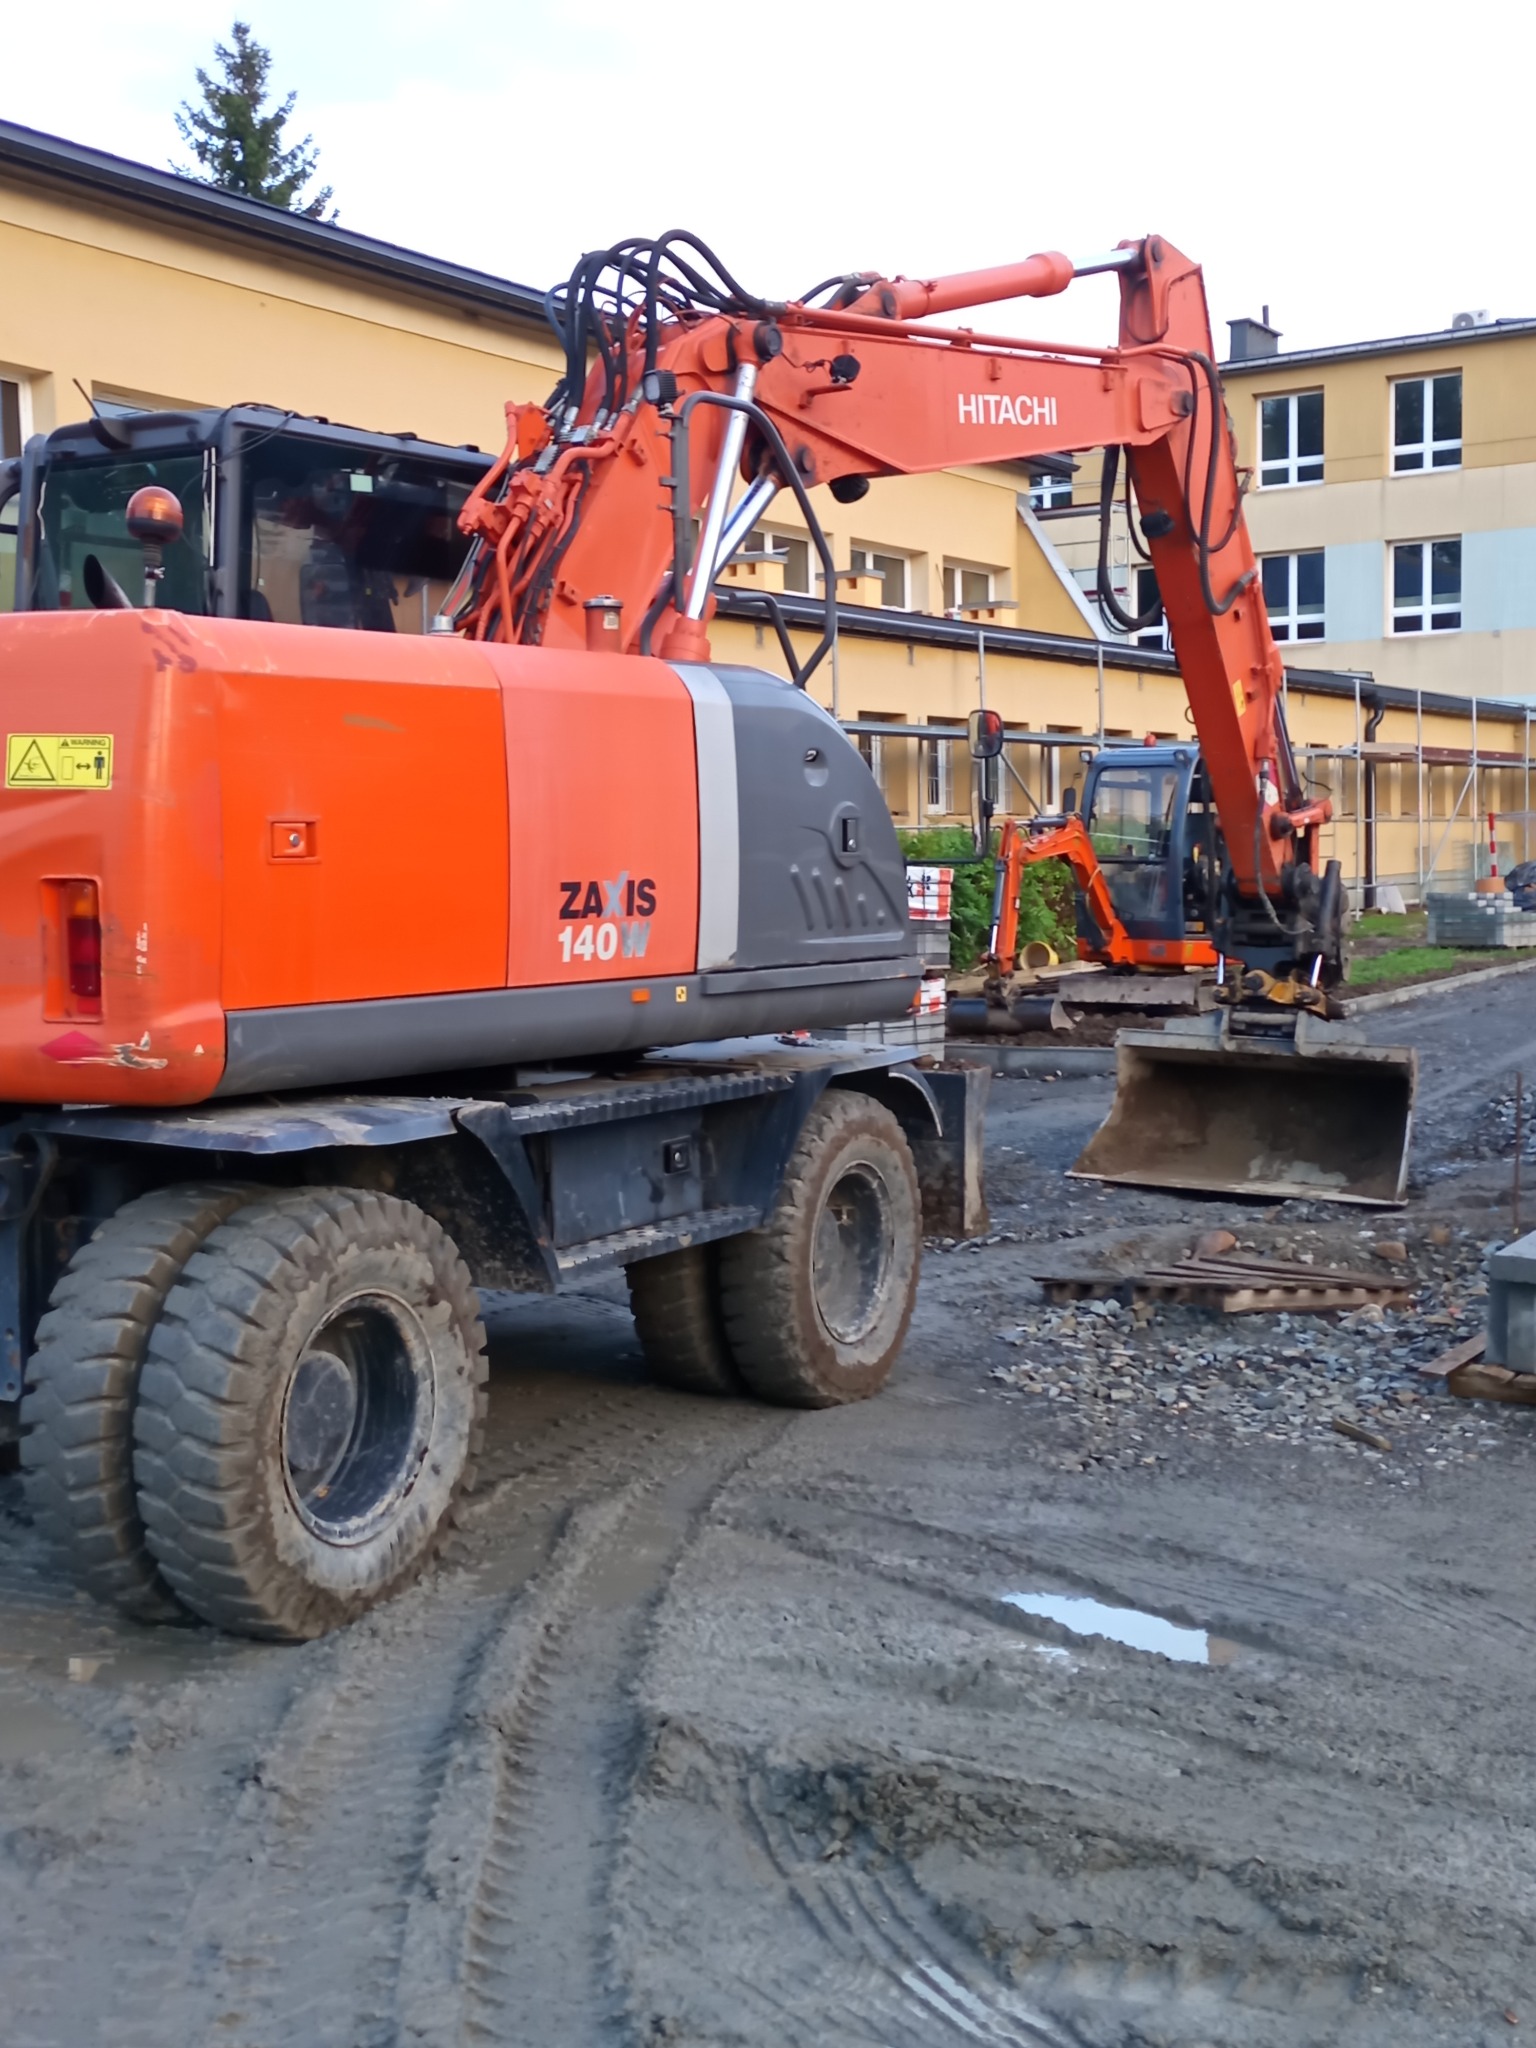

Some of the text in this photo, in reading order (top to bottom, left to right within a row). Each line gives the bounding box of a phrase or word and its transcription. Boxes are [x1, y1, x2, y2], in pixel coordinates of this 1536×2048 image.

[957, 393, 1058, 426] HITACHI
[70, 739, 107, 747] WARNING
[559, 870, 657, 920] ZAXIS
[558, 920, 652, 963] 140W
